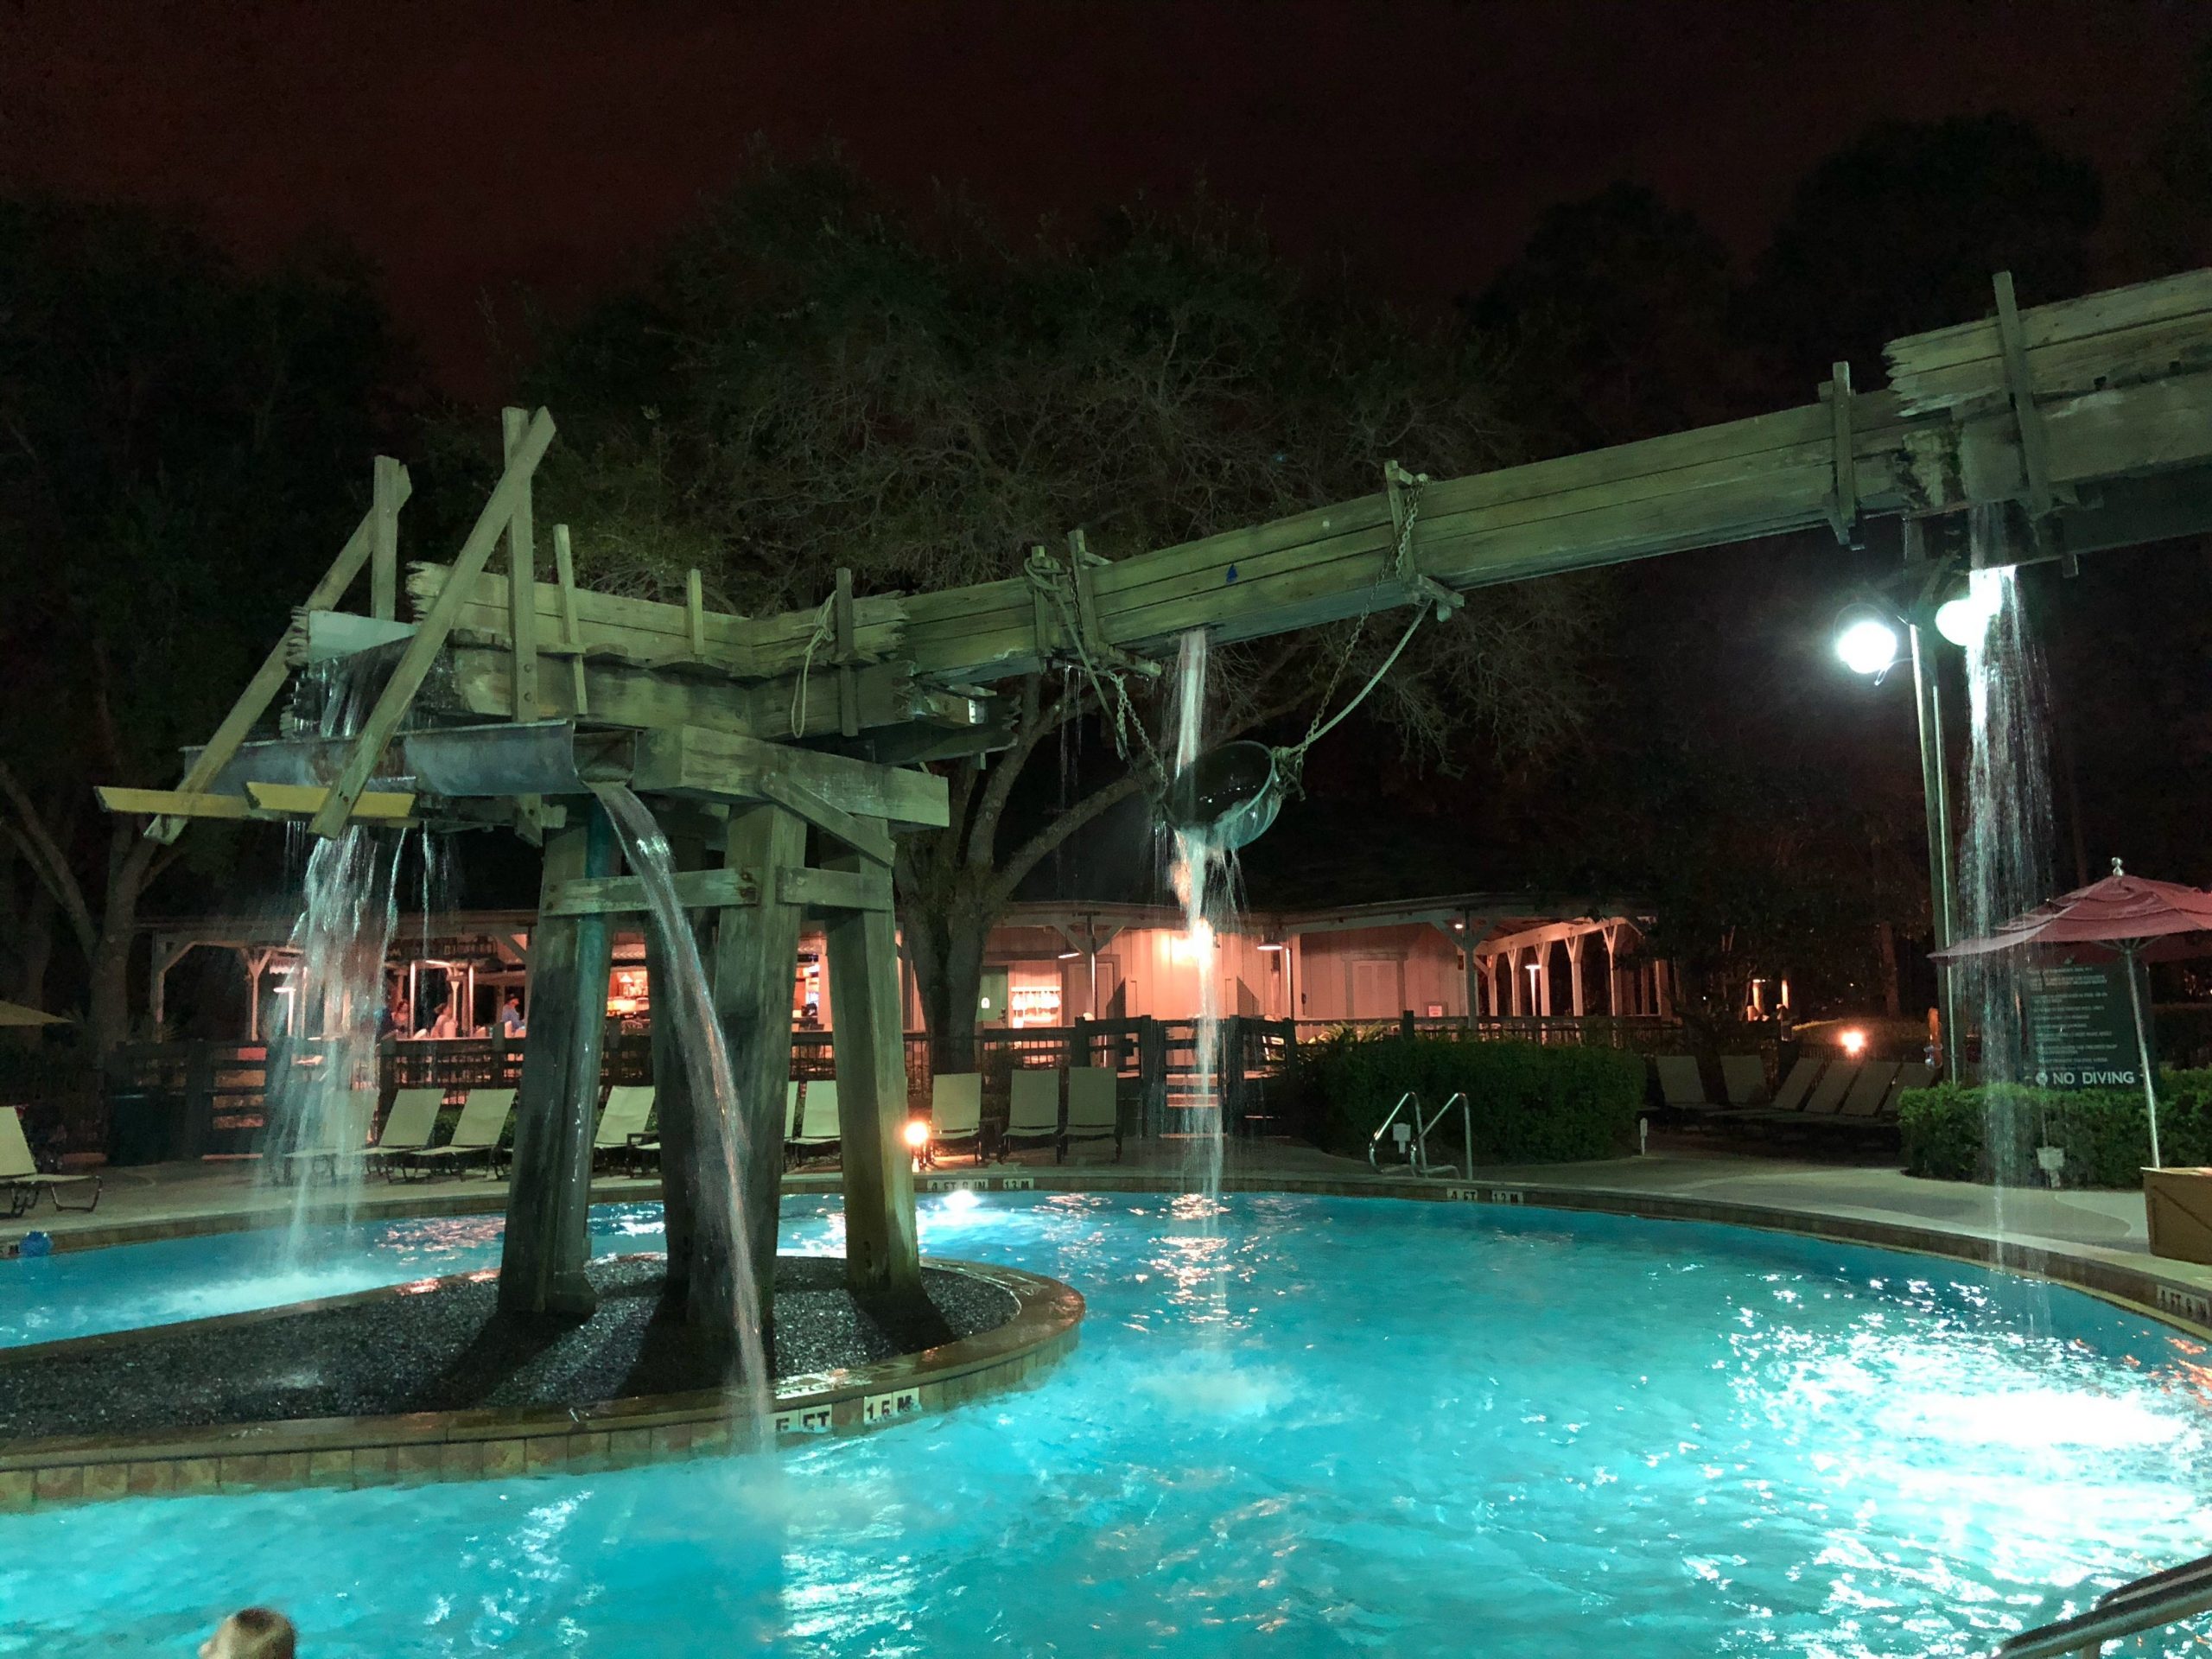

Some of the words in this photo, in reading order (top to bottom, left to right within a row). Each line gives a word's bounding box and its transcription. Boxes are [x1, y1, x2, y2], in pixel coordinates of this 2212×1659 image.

[2052, 1072, 2075, 1085] NO
[2082, 1071, 2135, 1085] DIVING
[897, 1395, 914, 1413] M
[803, 1410, 830, 1431] FT
